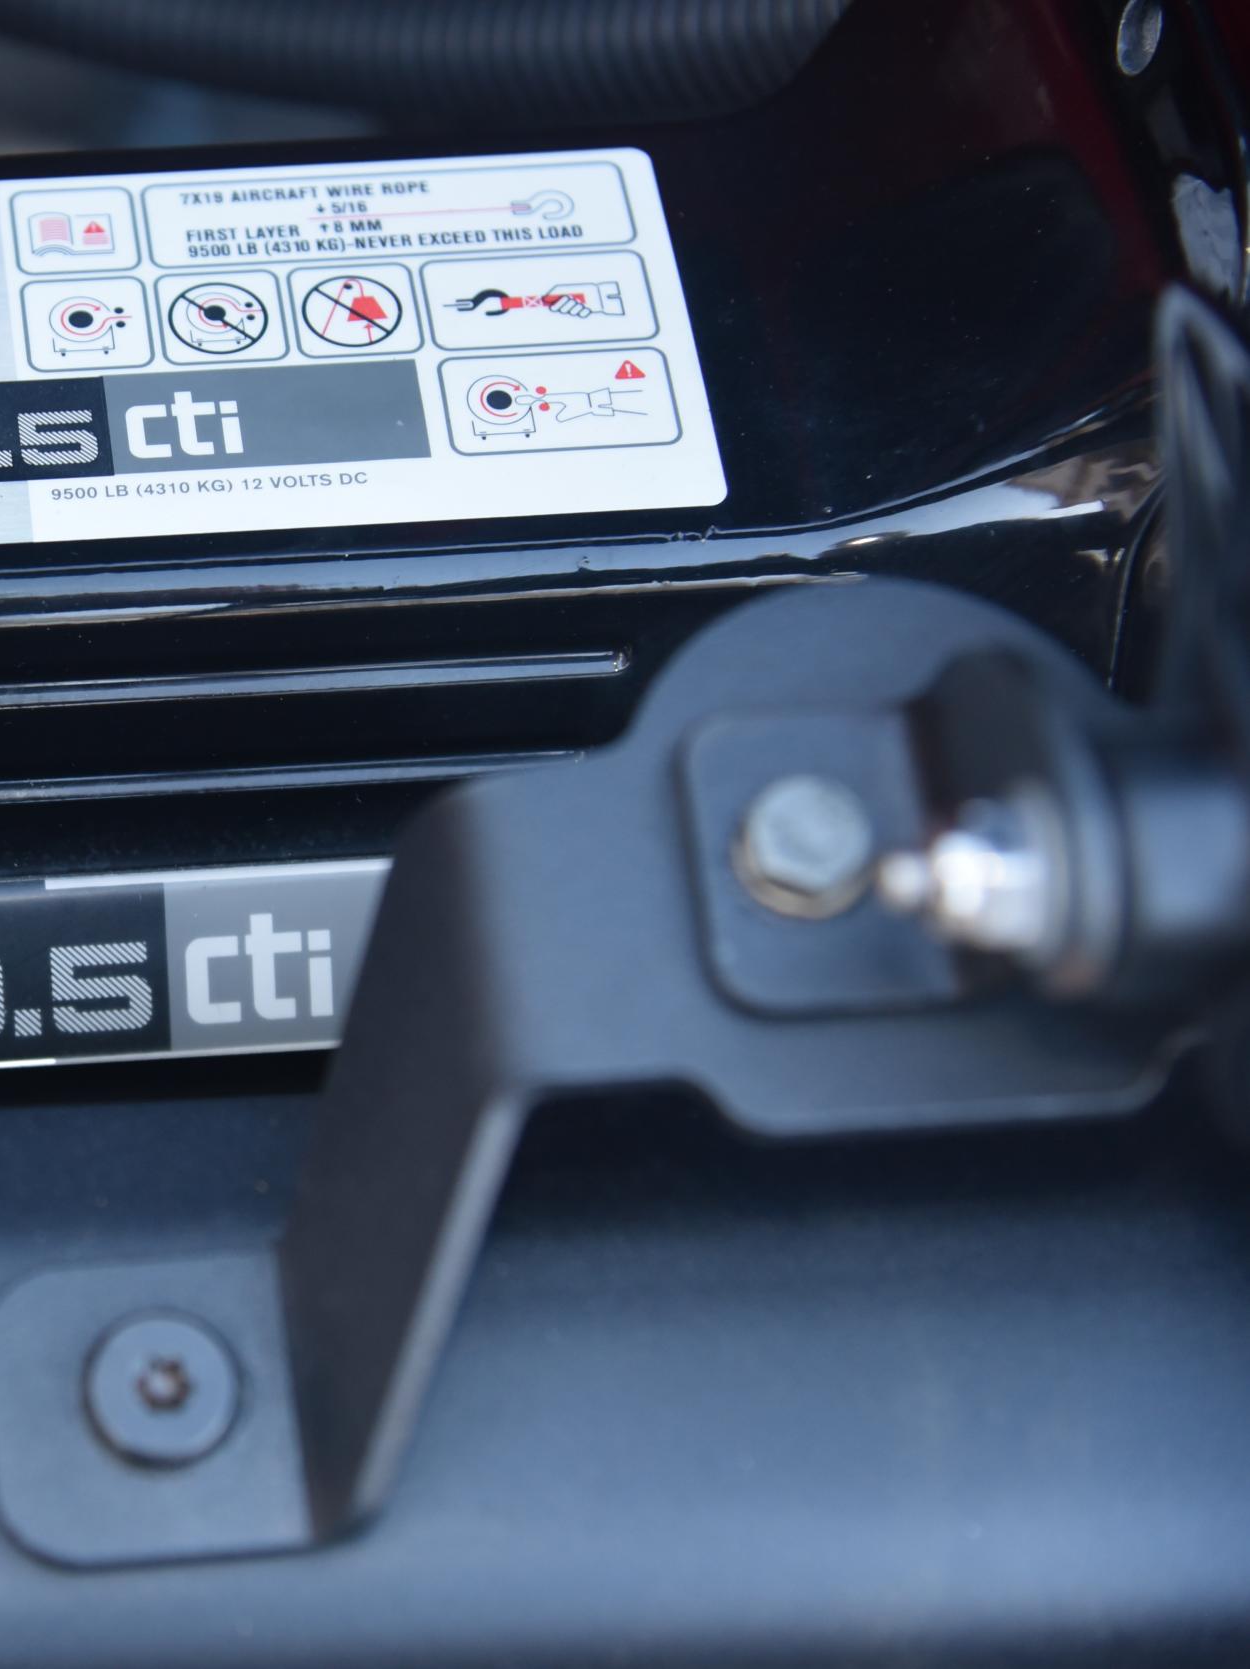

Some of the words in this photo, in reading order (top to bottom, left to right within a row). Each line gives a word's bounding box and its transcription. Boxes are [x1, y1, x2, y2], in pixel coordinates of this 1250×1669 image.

[231, 185, 318, 203] AIRCRAFT
[326, 183, 375, 198] WIRE
[382, 180, 430, 194] ROPE
[332, 200, 368, 214] 5/16
[186, 228, 237, 242] FIRST
[245, 224, 301, 240] LAYER
[350, 219, 383, 232] MM
[188, 243, 231, 258] 9500
[238, 242, 259, 255] LB
[264, 239, 311, 257] (4310
[418, 228, 486, 247] EXCEED
[493, 226, 533, 242] THIS
[538, 223, 584, 240] LOAD
[124, 391, 245, 459] cti
[51, 486, 99, 501] 9500
[105, 483, 130, 498] LB
[135, 480, 193, 499] (4310
[197, 478, 234, 496] KG)
[241, 477, 264, 491] 12
[269, 473, 333, 490] VOLTS
[338, 471, 369, 486] DC
[185, 913, 334, 1025] cti
